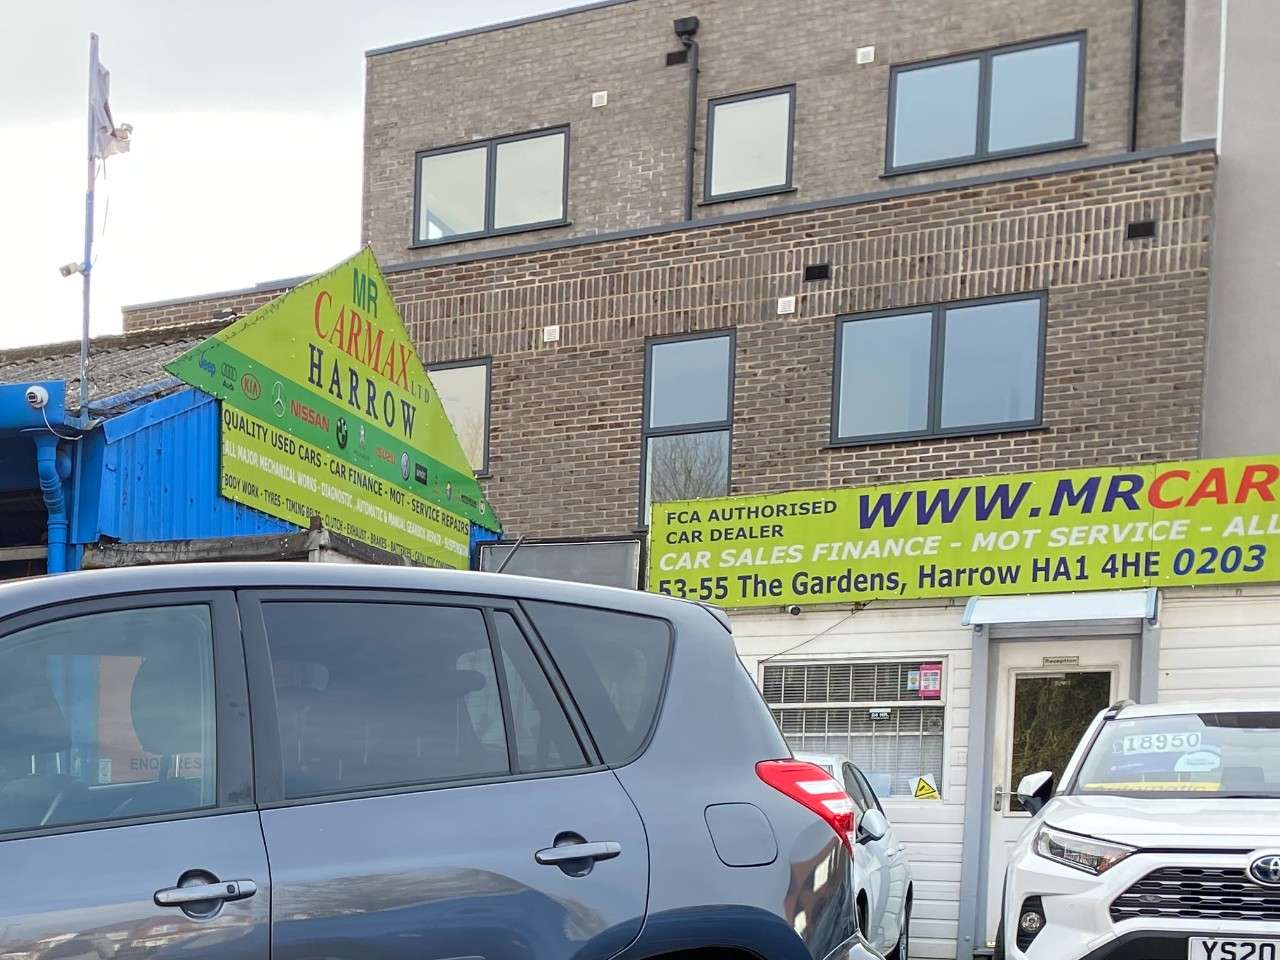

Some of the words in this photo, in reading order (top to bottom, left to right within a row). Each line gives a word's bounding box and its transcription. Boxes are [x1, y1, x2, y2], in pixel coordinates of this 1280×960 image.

[353, 267, 378, 319] MR
[314, 290, 413, 393] CARMAX
[411, 380, 430, 404] LTD
[243, 381, 258, 397] KIA
[308, 343, 417, 440] HARROW
[290, 399, 330, 432] NISSAN
[224, 409, 268, 443] QUALITY
[271, 430, 296, 455] USED
[298, 444, 322, 468] CARS
[330, 460, 346, 479] CAR
[349, 468, 383, 496] FINANCE
[390, 488, 405, 506] MOT
[412, 498, 439, 522] SERVICE
[441, 512, 469, 536] REPAIRS
[237, 443, 258, 467] MAJOR
[259, 455, 297, 484] MECHANICAL
[224, 473, 240, 490] BODY
[242, 478, 259, 497] WORK
[264, 489, 281, 507] TYRES
[286, 498, 305, 517] TIMING
[666, 511, 701, 525] FCA
[708, 500, 838, 522] AUTHORISED
[859, 464, 1279, 530] WWW.MRCAR
[659, 549, 710, 572] CAR
[719, 544, 804, 568] SALES
[812, 535, 942, 562] FINANCE
[971, 529, 1042, 552] MOT
[1047, 519, 1191, 548] SERVICE
[1222, 513, 1280, 537] ALL
[666, 530, 703, 544] CAR
[710, 524, 784, 542] DEALER
[659, 576, 729, 600] 53-55
[737, 573, 783, 598] The
[791, 568, 907, 596] Gardens,
[919, 563, 1020, 589] Harrow
[1032, 555, 1089, 583] HA1
[1101, 551, 1161, 579] 4HE
[1173, 543, 1267, 576] 0203
